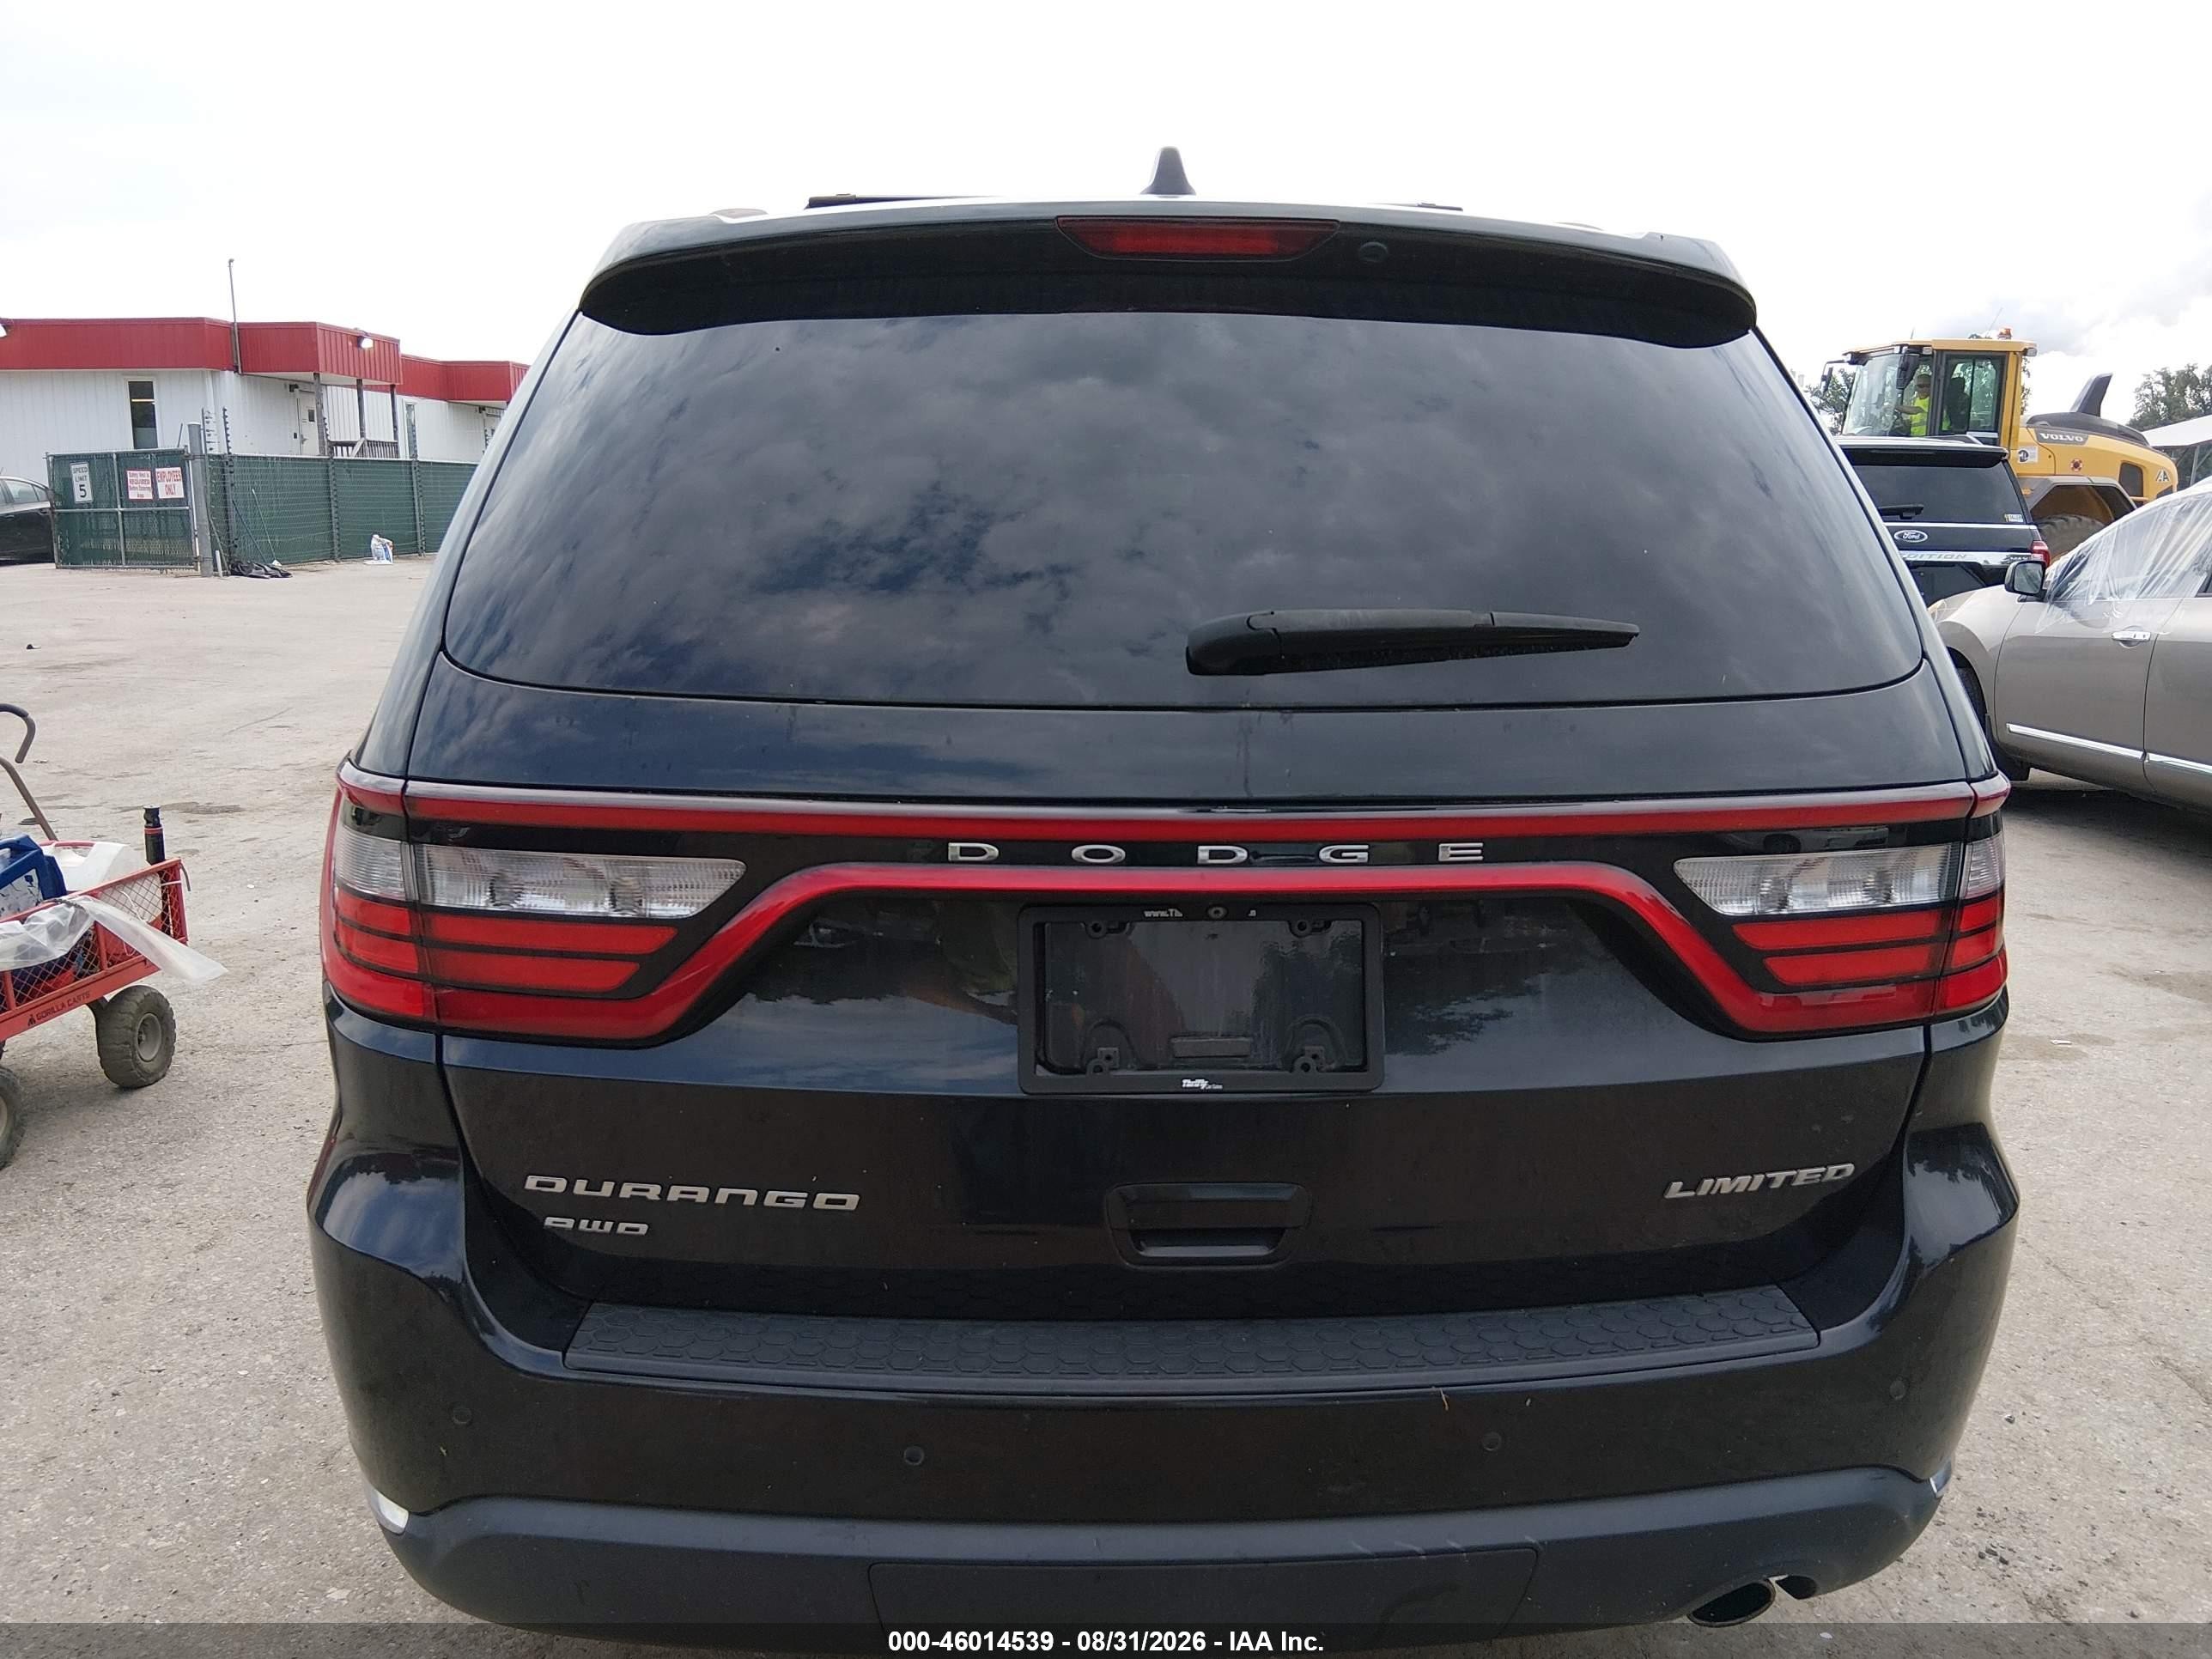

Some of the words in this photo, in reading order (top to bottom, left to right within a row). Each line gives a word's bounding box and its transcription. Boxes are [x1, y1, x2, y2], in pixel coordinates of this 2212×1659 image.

[2040, 433, 2084, 442] VOLVO
[157, 471, 181, 482] EMPLOYEES
[79, 484, 87, 497] 5
[165, 483, 176, 495] ONLY
[948, 842, 1484, 865] DODGE
[36, 1002, 66, 1020] GORILLA
[67, 991, 90, 1006] CARTS
[1663, 1163, 1856, 1199] LIMITED
[525, 1175, 860, 1211] DURANGO
[544, 1216, 648, 1236] AWD
